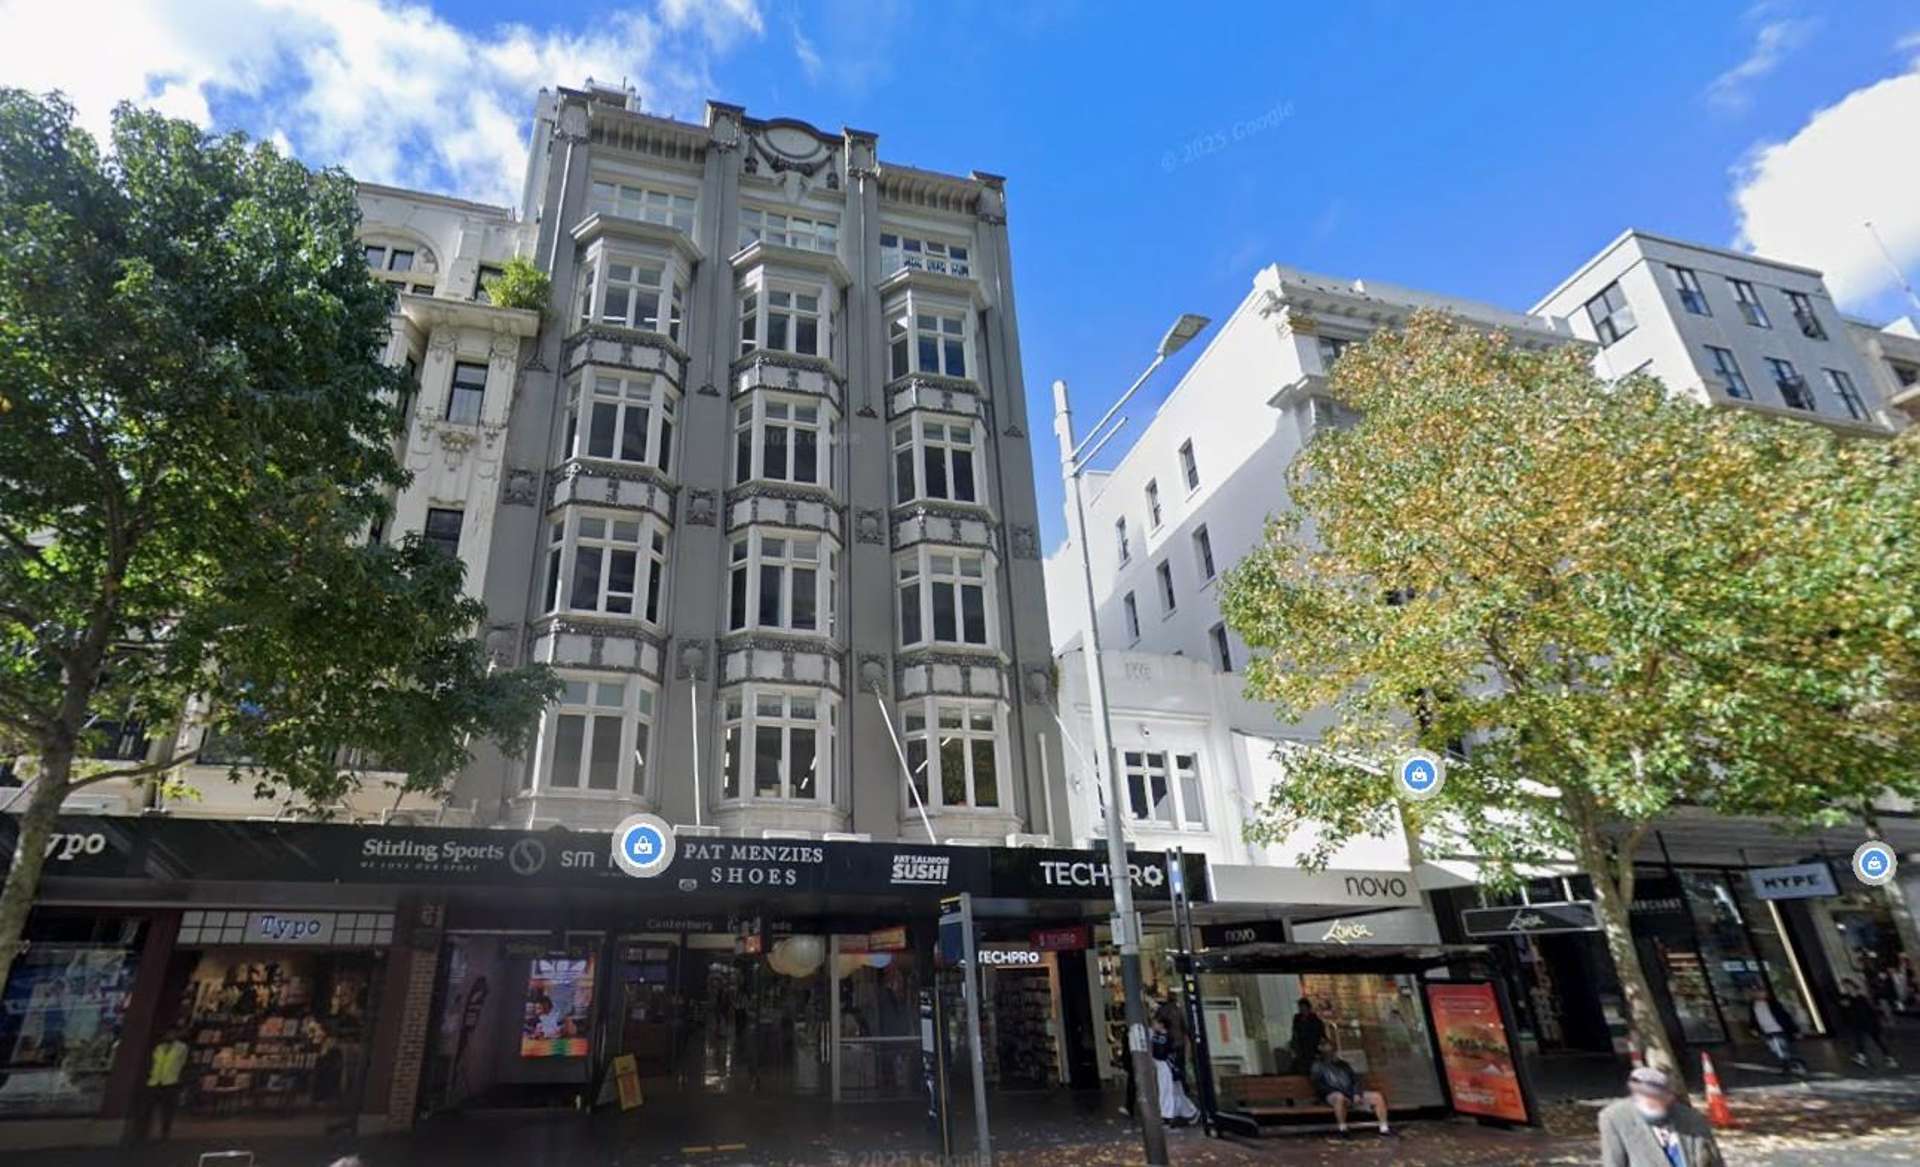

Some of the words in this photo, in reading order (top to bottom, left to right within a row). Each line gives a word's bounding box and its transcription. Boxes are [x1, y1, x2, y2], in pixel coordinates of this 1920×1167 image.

[43, 833, 107, 861] ypo
[361, 838, 438, 862] Stirling
[442, 841, 505, 863] Sports
[684, 843, 725, 860] PAT
[730, 845, 824, 864] MENZIES
[711, 867, 797, 886] SHOES
[891, 863, 949, 880] SUSHI
[1039, 861, 1164, 888] TECHRO
[1761, 873, 1818, 889] HYPE
[1345, 876, 1407, 898] novo
[260, 915, 321, 939] Typo
[1224, 929, 1256, 943] novo
[978, 950, 1040, 965] TECHPRO
